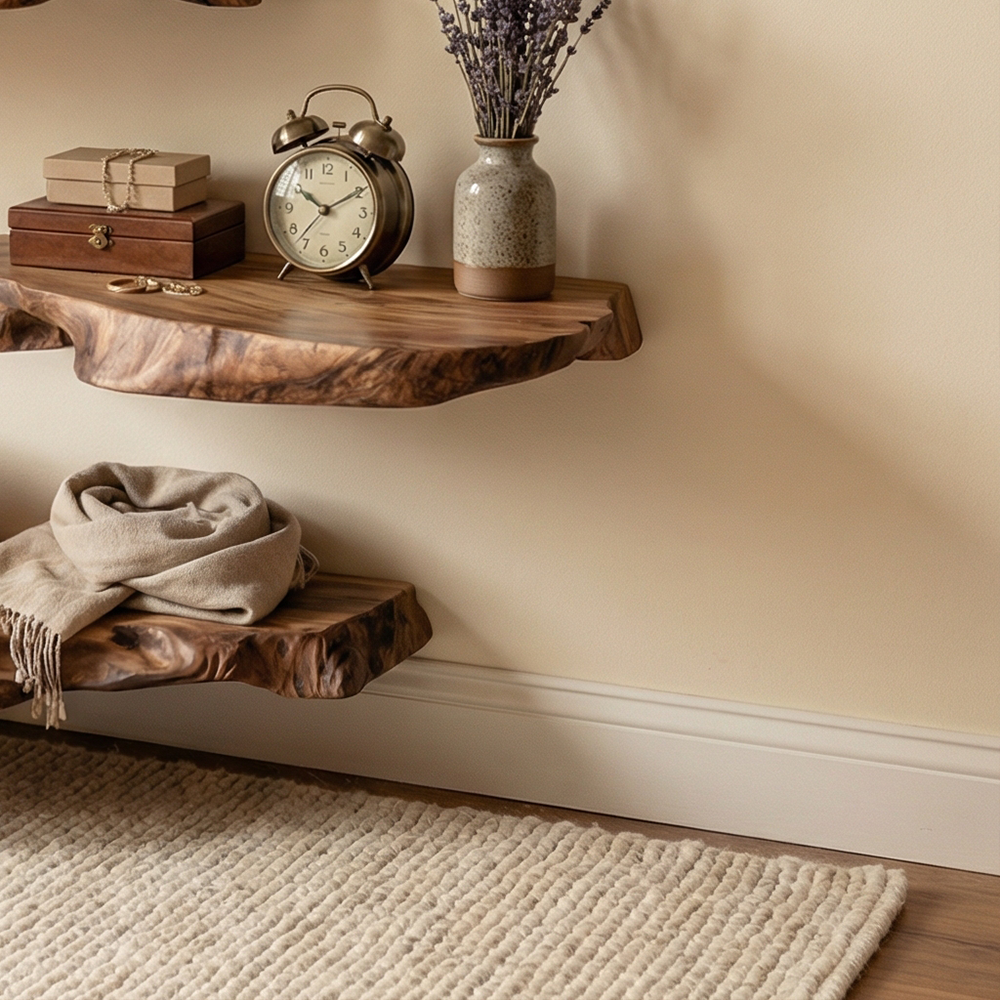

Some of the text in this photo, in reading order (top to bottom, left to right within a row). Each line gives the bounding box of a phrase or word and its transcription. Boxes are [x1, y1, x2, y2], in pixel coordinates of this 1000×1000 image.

[305, 169, 312, 179] 11
[322, 163, 333, 175] 12
[345, 170, 348, 182] 1
[285, 202, 294, 214] 9
[359, 207, 367, 219] 3
[290, 223, 298, 234] 8
[352, 227, 361, 238] 4
[302, 238, 310, 250] 7
[338, 241, 347, 252] 5
[320, 245, 328, 256] 6
